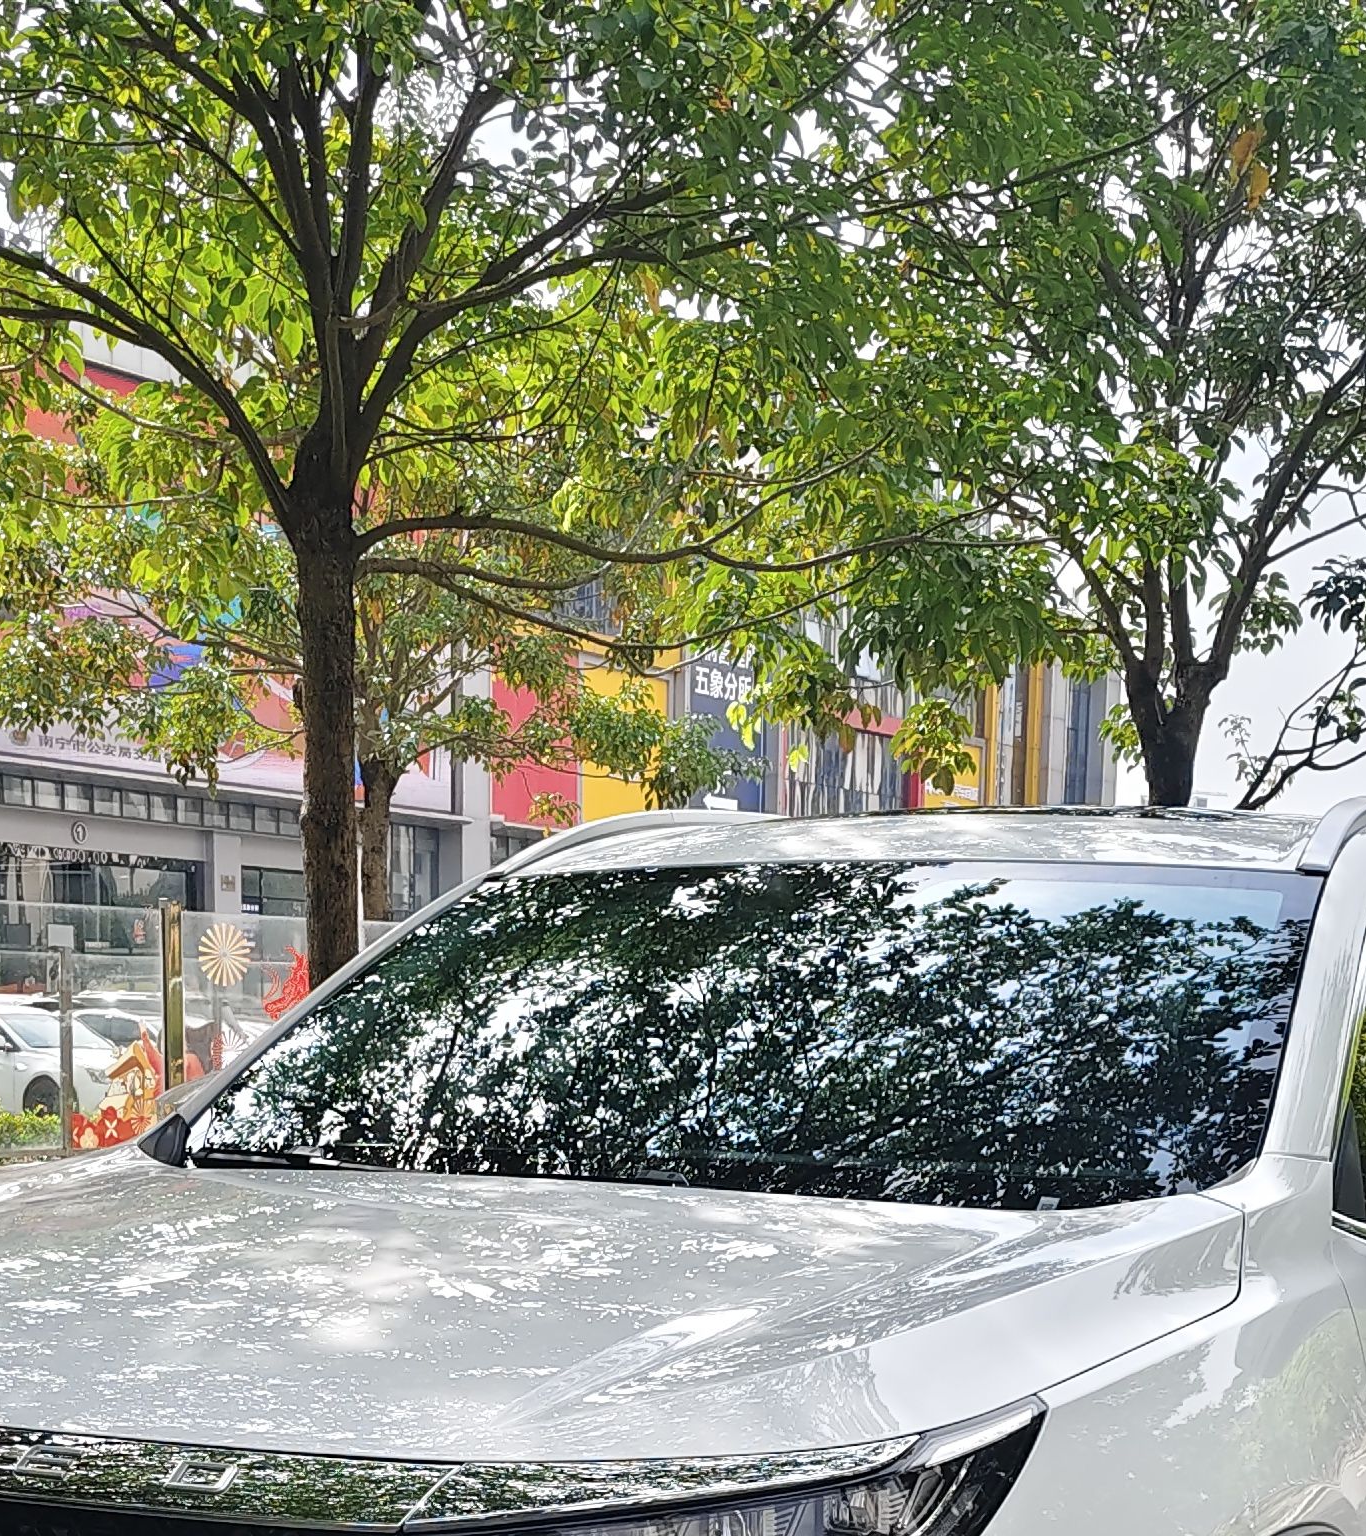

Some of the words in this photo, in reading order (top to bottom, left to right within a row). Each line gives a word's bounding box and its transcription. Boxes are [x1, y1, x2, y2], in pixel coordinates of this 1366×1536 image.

[695, 666, 752, 702] 五象分所
[39, 735, 172, 764] 南宁市公安局交
